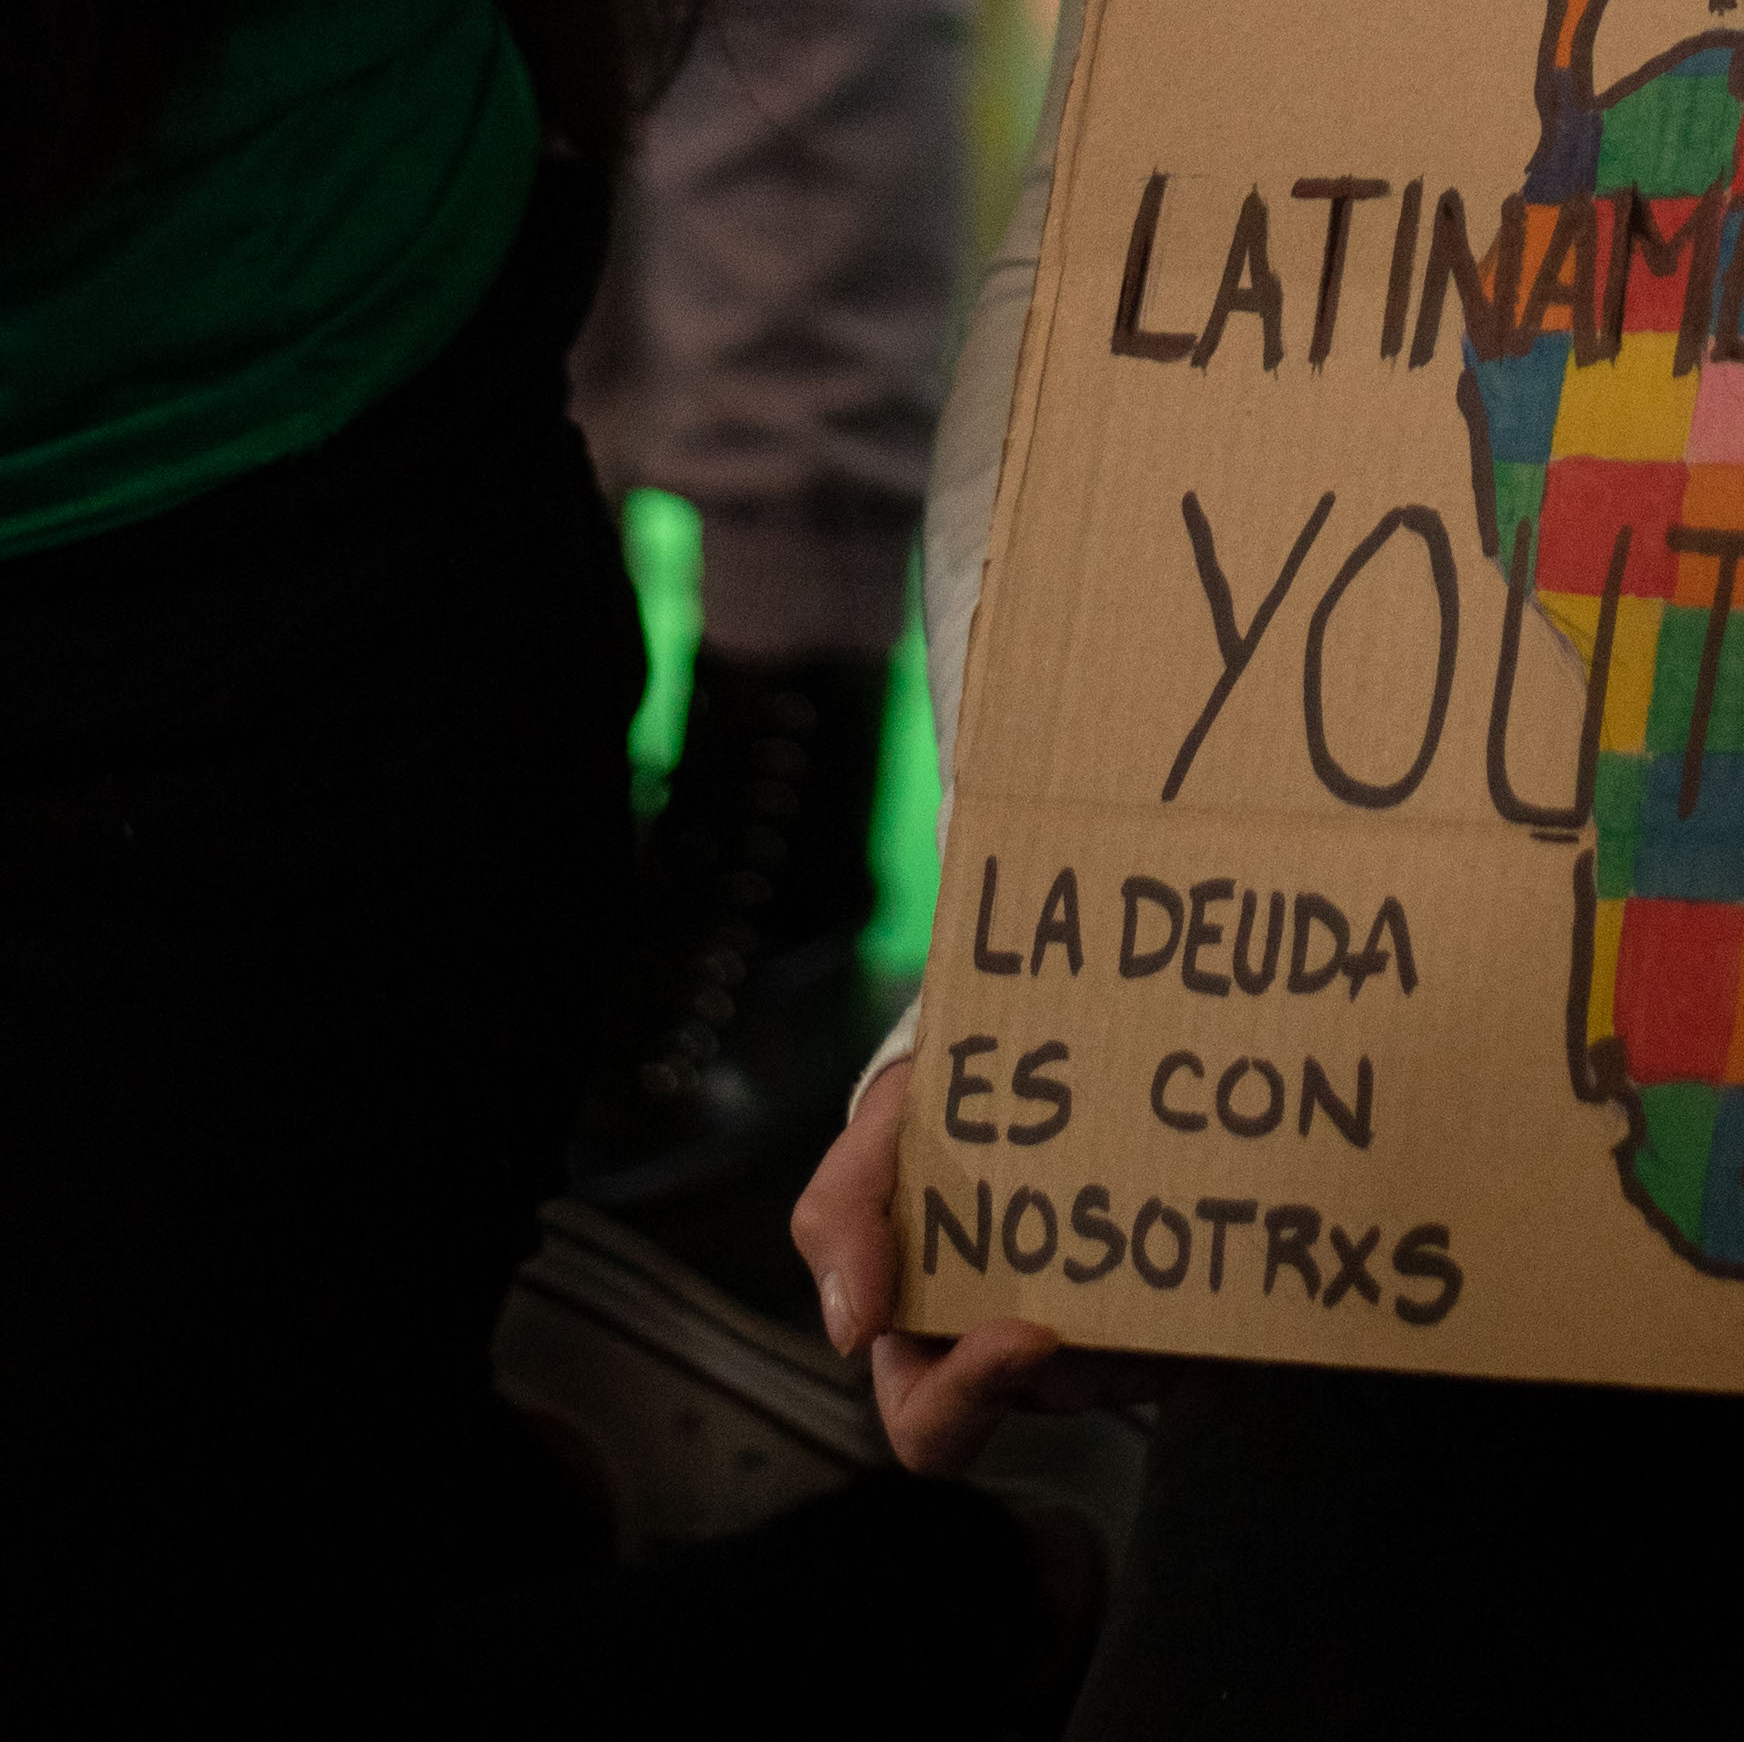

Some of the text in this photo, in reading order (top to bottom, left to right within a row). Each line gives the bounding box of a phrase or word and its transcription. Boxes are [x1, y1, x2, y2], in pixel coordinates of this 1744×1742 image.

[973, 855, 1419, 1003] LA DEUDA
[944, 1035, 1375, 1150] ES CON
[922, 1178, 1463, 1327] NOSOTRXS
